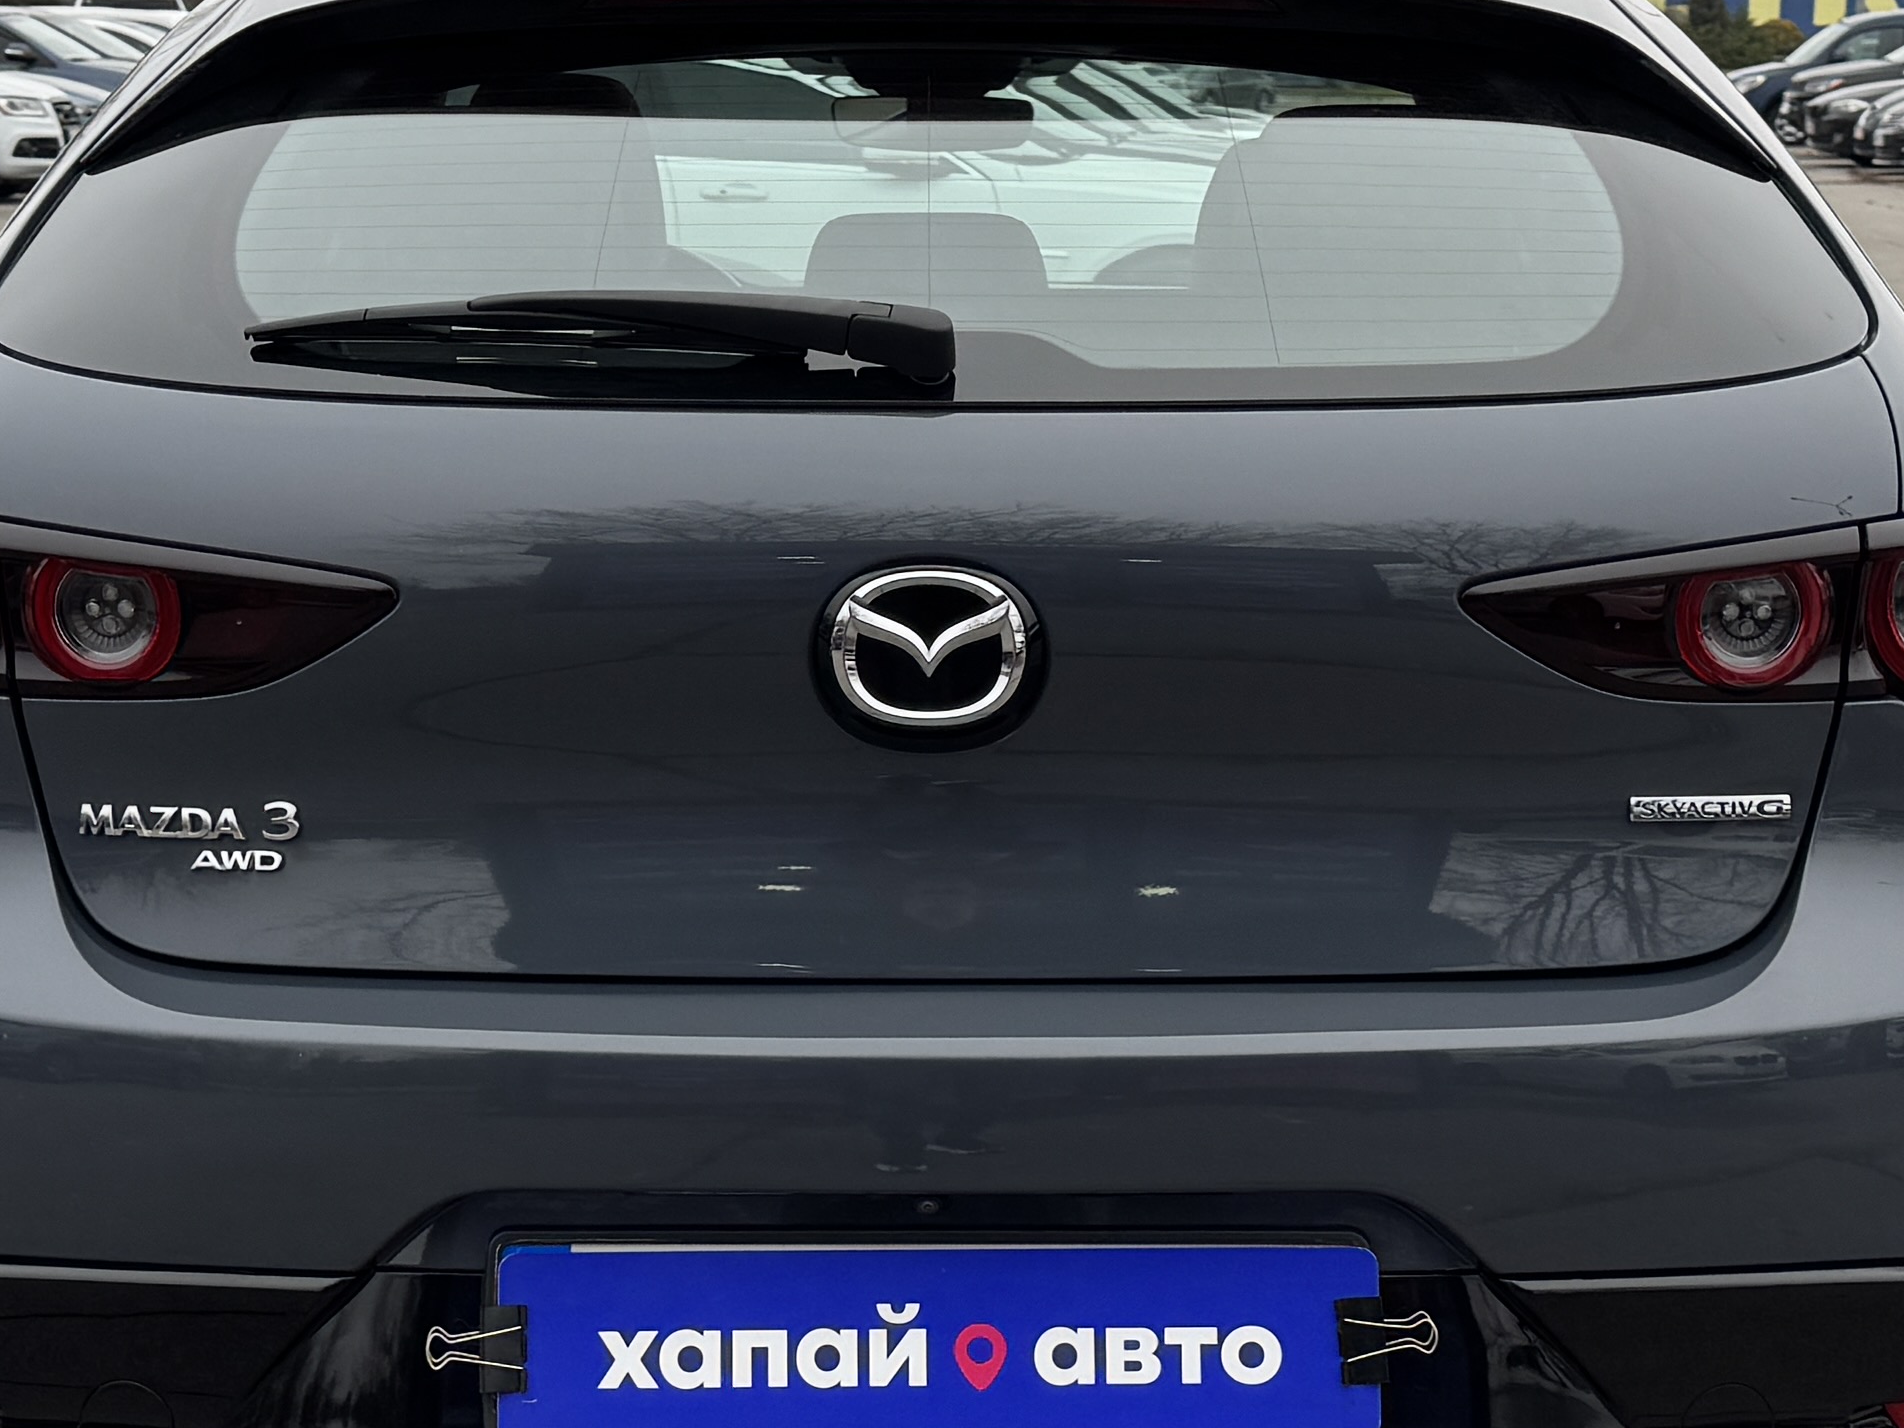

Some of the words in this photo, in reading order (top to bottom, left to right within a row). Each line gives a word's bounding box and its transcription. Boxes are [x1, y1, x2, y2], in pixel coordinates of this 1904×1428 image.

[79, 802, 246, 841] MAZDA
[261, 800, 301, 841] 3
[189, 849, 284, 872] AWD
[596, 1302, 928, 1390] хапай
[1033, 1324, 1284, 1386] авто
